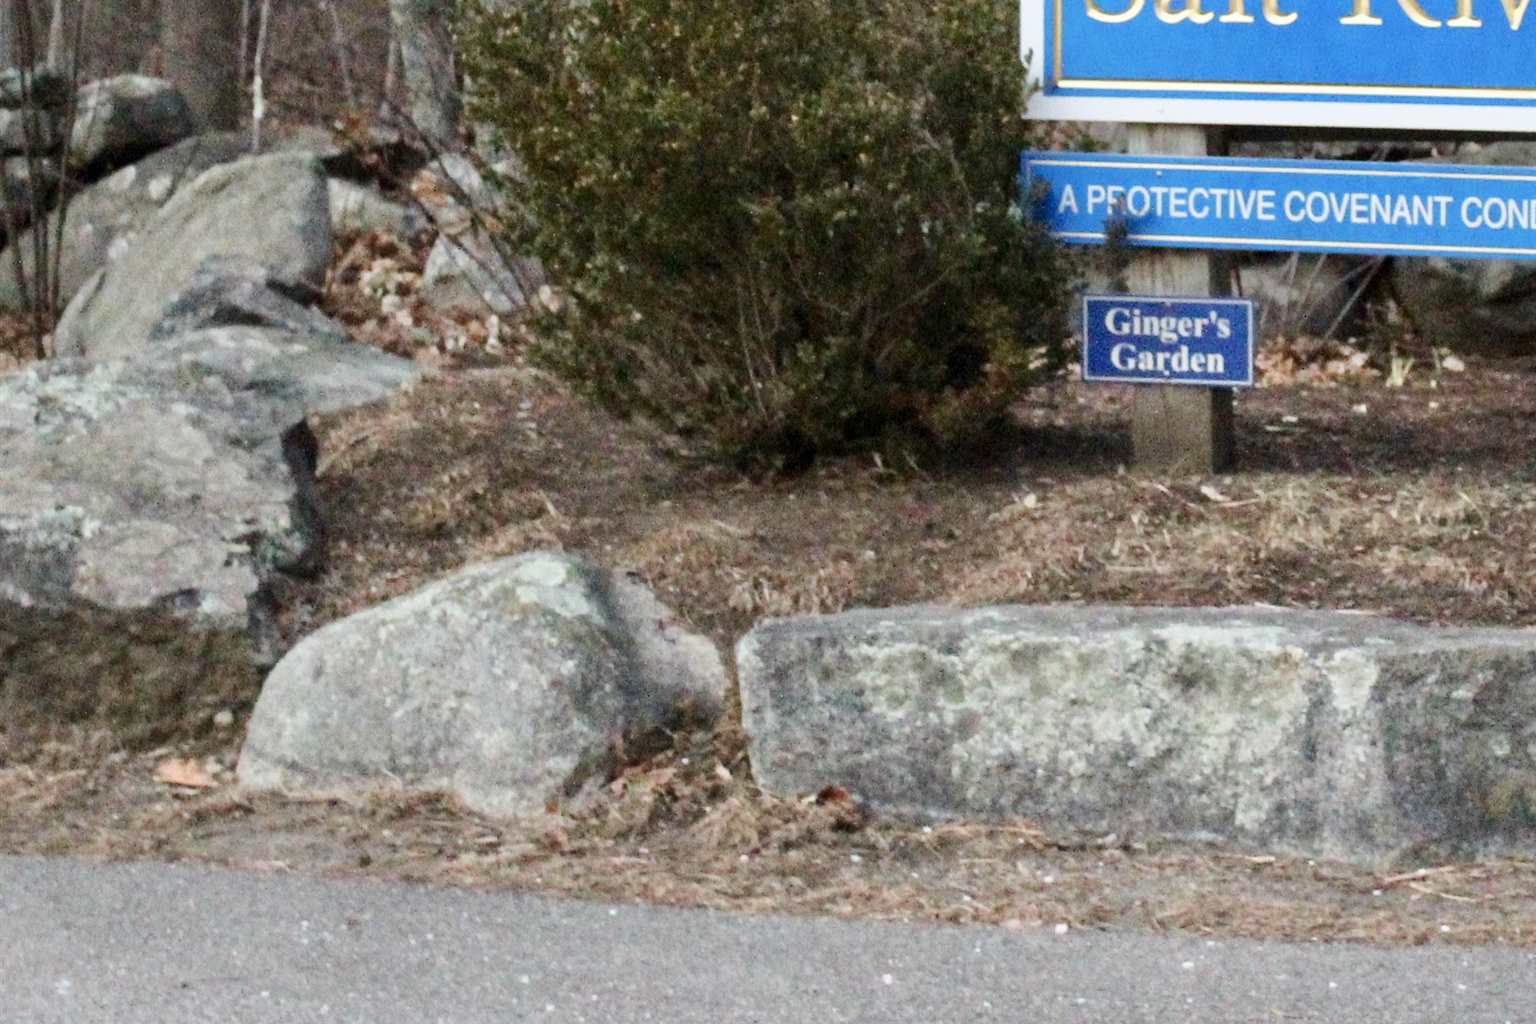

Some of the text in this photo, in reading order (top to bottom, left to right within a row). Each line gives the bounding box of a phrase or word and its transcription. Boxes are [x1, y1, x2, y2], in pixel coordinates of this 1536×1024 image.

[1057, 183, 1079, 215] A
[1086, 183, 1275, 222] PROTECTIVE
[1284, 189, 1454, 228] COVENANT
[1104, 307, 1232, 344] Ginger's
[1109, 342, 1226, 374] Garden
